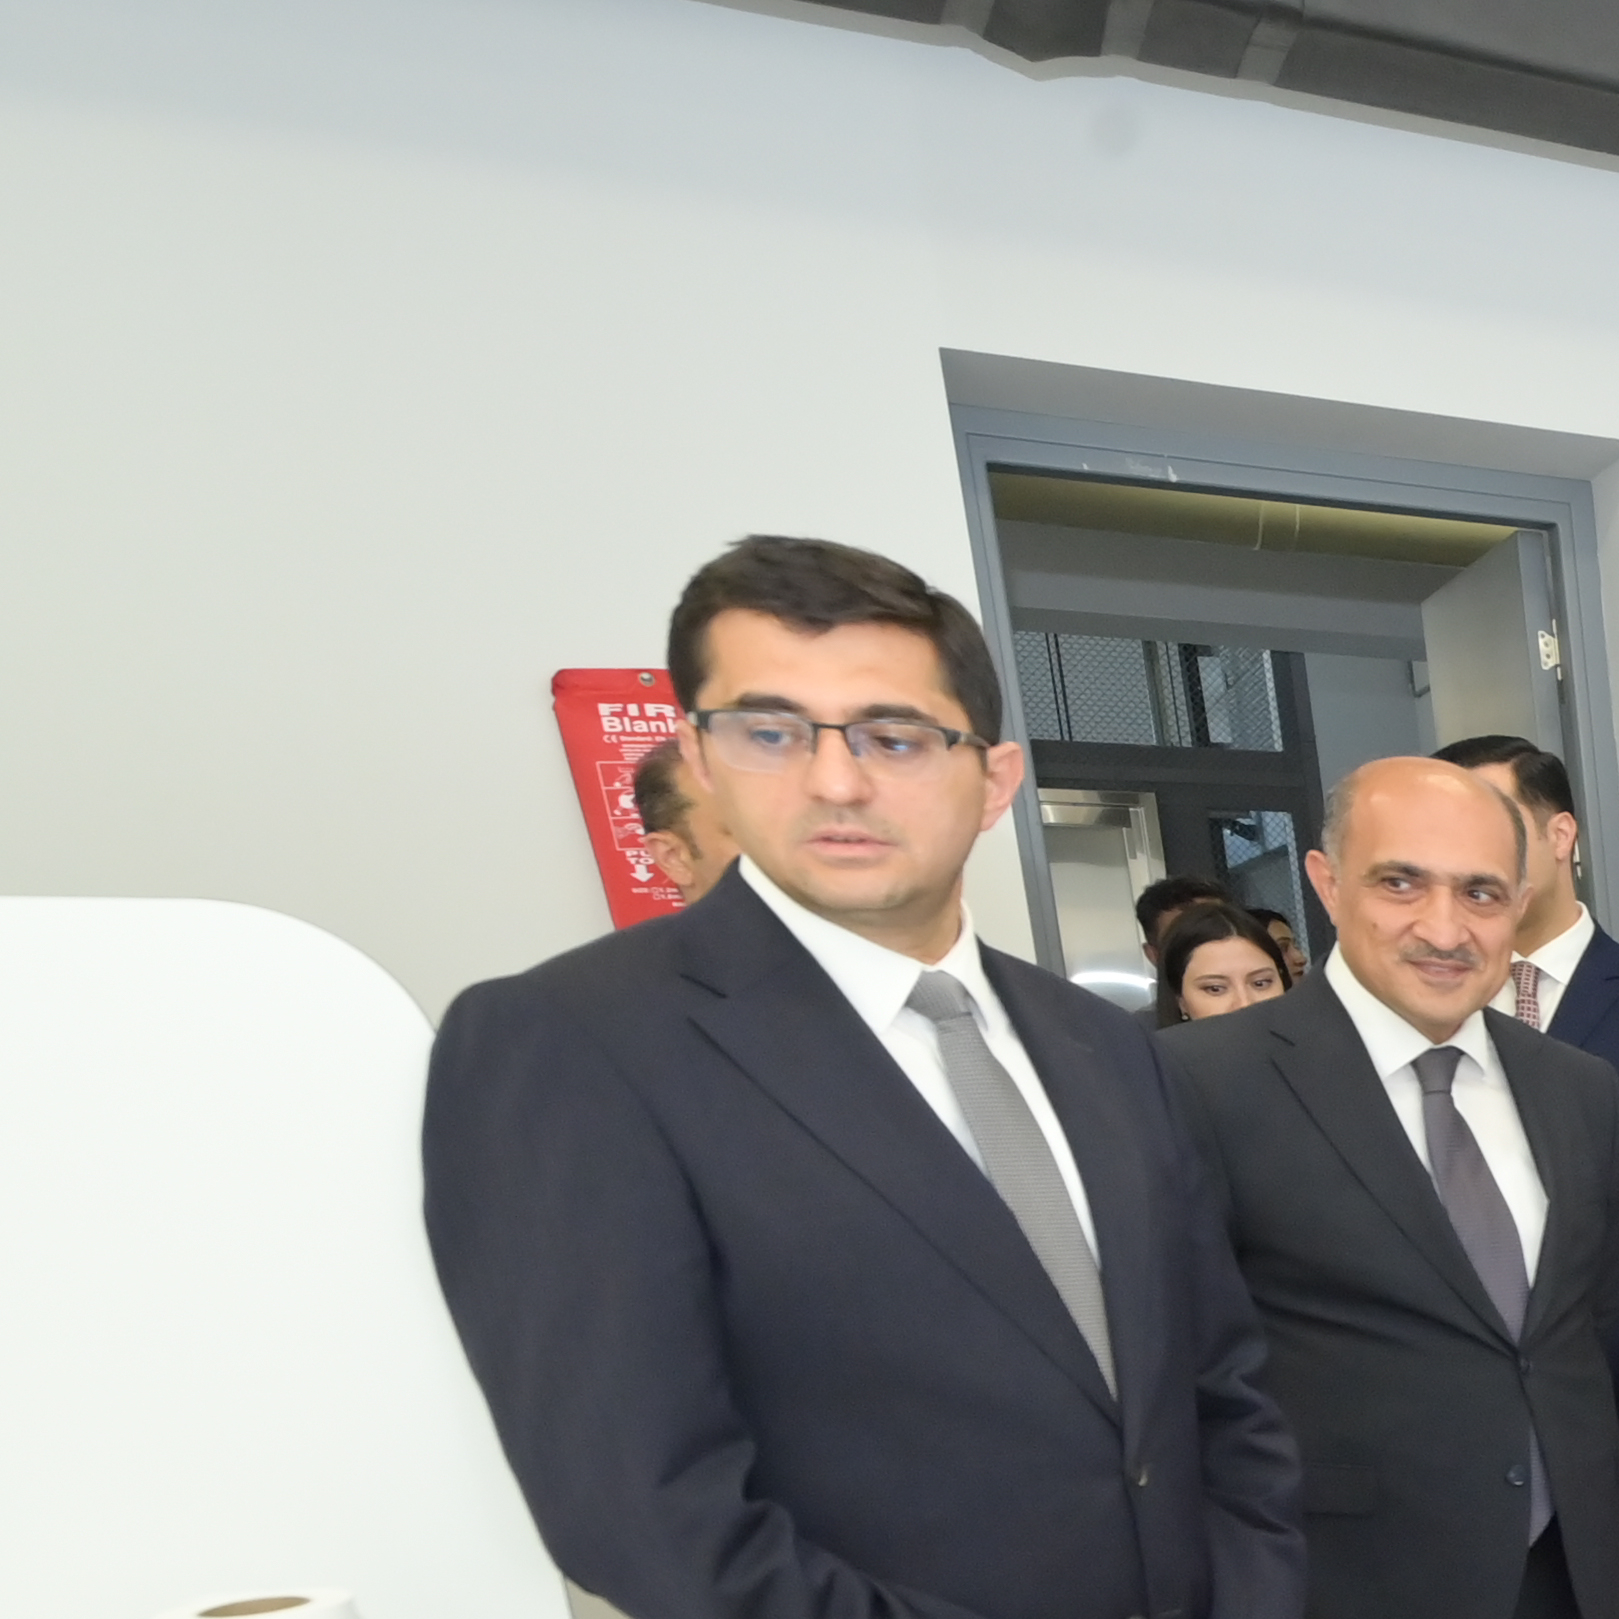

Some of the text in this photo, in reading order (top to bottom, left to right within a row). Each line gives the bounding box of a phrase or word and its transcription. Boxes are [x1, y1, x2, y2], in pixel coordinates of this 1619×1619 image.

[597, 703, 676, 717] FIR
[601, 716, 677, 734] Blank
[626, 857, 655, 865] TO
